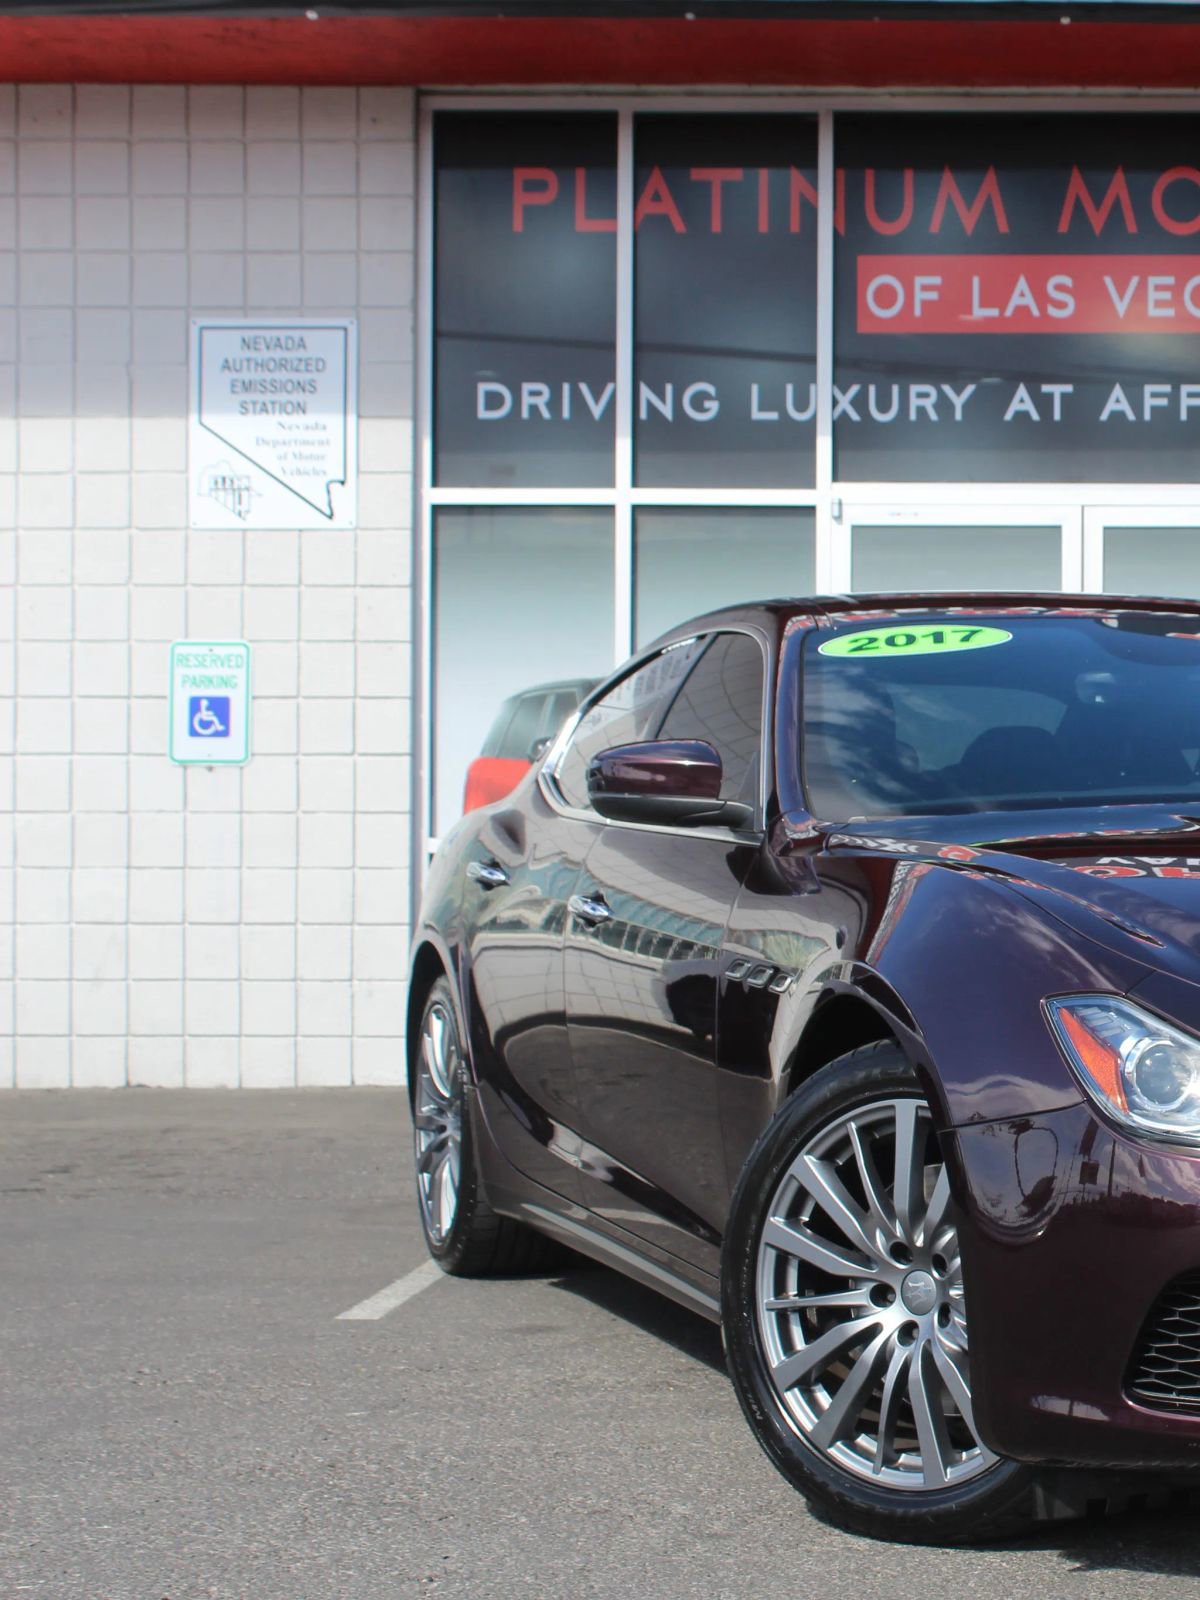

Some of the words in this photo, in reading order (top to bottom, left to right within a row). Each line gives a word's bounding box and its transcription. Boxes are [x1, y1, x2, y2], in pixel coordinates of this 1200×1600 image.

[511, 165, 1009, 236] PLATINUM
[866, 275, 942, 318] OF
[972, 275, 1076, 318] LAS
[240, 335, 308, 351] NEVADA
[220, 357, 326, 374] AUTHORIZED
[230, 379, 318, 394] EMISSIONS
[238, 400, 307, 416] STATION
[476, 382, 720, 422] DRIVNG
[751, 383, 976, 422] LUXURY
[1004, 383, 1073, 422] AT
[847, 628, 984, 653] 2017
[175, 653, 244, 669] RESERVED
[181, 674, 238, 689] PARKING
